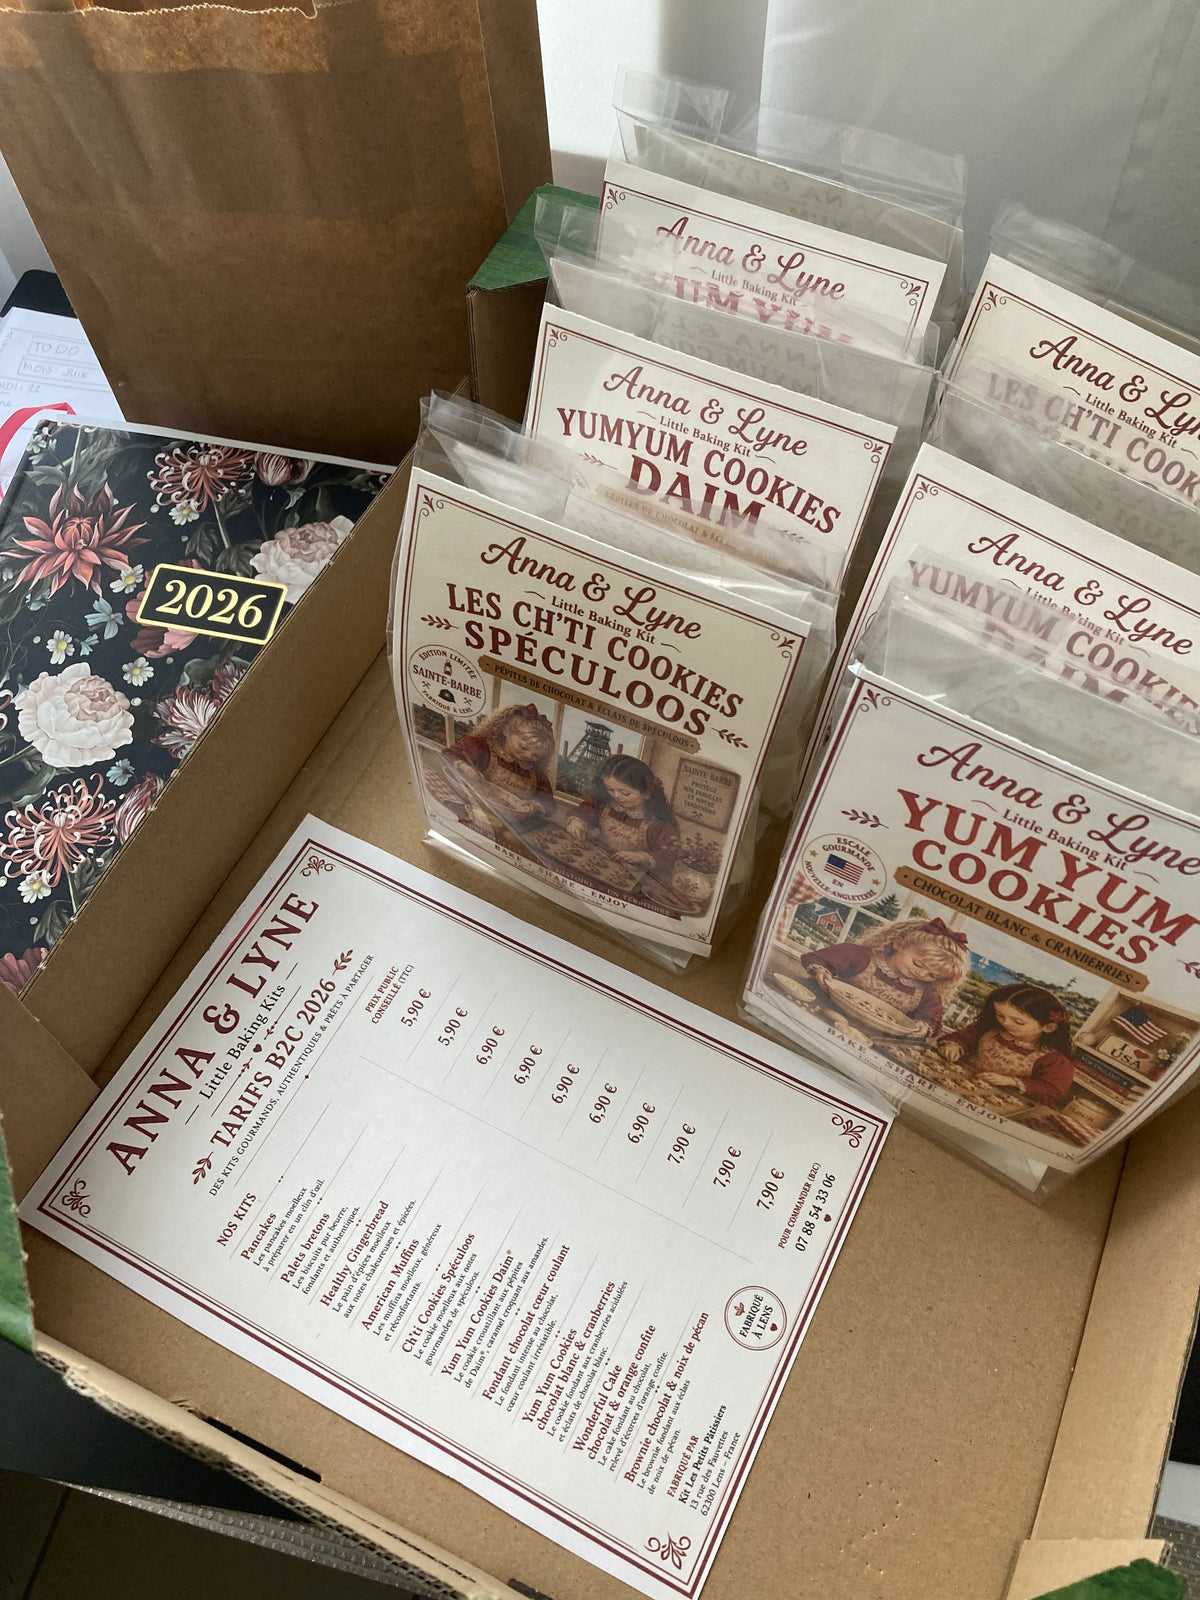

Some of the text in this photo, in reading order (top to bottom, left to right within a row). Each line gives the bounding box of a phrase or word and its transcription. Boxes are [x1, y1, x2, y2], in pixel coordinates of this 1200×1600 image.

[656, 216, 735, 266] Anna
[742, 244, 766, 273] &
[766, 252, 846, 300] Lyne
[711, 269, 739, 287] Little
[741, 280, 778, 301] Baking
[1029, 335, 1116, 391] Anna
[1119, 375, 1149, 403] &
[603, 366, 808, 457] Anna & Lyne
[660, 415, 752, 458] Little Baking Kit
[1044, 395, 1122, 449] CH'TI
[1085, 392, 1178, 449] Little Baking Kit
[556, 407, 841, 534] YUMYUM COOKIES
[625, 454, 767, 538] DAIM
[155, 579, 268, 628] 2026
[480, 537, 702, 639] Anna & Lyne
[551, 596, 656, 645] Little Baking Kit
[908, 560, 1062, 642] YUMYUM
[967, 533, 1065, 592] Anna
[1074, 579, 1104, 606] &
[1103, 594, 1194, 655] Lyne
[1025, 586, 1058, 610] Little
[1105, 628, 1126, 647] Kit
[412, 664, 482, 699] SAINTE-BARBE
[446, 583, 744, 718] LES CH'TI COOKIES
[464, 620, 711, 736] SPÉCULOOS
[494, 664, 527, 684] PÉPITES
[529, 678, 541, 689] DE
[542, 683, 586, 708] CHOCOLAT
[588, 701, 594, 710] &
[629, 717, 641, 728] DE
[917, 742, 1200, 876] Anna & Lyne
[1002, 808, 1129, 871] Little Baking Kit
[494, 844, 522, 863] BAKE
[538, 866, 576, 889] SHARE
[591, 890, 629, 909] ENJOY
[822, 837, 876, 872] ESCALE GOURMANDE
[831, 879, 844, 888] EN
[897, 788, 1200, 947] YUM YUM
[911, 839, 1160, 964] COOKIES
[912, 876, 1133, 984] CHOCOLAT BLANC & CRANBERRIES
[364, 965, 399, 1013] PRIX PUBLIC
[370, 963, 414, 1024] CONSEILLÉ (TTC)
[400, 987, 431, 1027] 5,90 €
[105, 891, 320, 1176] ANNA & LYNE
[198, 984, 285, 1099] Little Baking Kits
[209, 977, 336, 1147] TARIFS B2C 2026
[475, 1025, 505, 1065] 6,90 €
[1110, 1048, 1141, 1070] USA
[208, 1177, 225, 1196] DES
[220, 1155, 239, 1177] KITS
[236, 1097, 280, 1155] GOURMANDS,
[276, 1030, 322, 1096] AUTHENTIQUES
[319, 1024, 327, 1032] &
[323, 999, 344, 1023] PRÊTS
[344, 954, 374, 992] PARTAGER
[550, 1063, 580, 1104] 6,90 €
[827, 1027, 868, 1054] BAKE
[884, 1060, 939, 1093] SHARE
[956, 1098, 1008, 1125] ENJOY
[216, 1192, 257, 1247] NOS KITS
[252, 1186, 307, 1266] Les pancakes moelleux
[755, 1167, 785, 1210] 7,90 €
[777, 1161, 821, 1249] POUR COMMANDER (B2C)
[794, 1172, 836, 1251] 07 88 54 33 06
[239, 1212, 277, 1260] Pancakes
[279, 1212, 330, 1283] Palets bretons
[319, 1199, 389, 1306] Healthy Gingerbread
[401, 1232, 475, 1353] Ch'ti Cookies Spéculoos
[738, 1293, 764, 1338] FABRIQUÉ
[749, 1304, 773, 1340] À LENS
[494, 1294, 559, 1406] Le fondant intense au chocolat,
[572, 1364, 622, 1450] Wonderful Cake
[666, 1434, 699, 1497] FABRIQUÉ PAR
[677, 1404, 727, 1504] Kit Les Petits Pâtissiers
[689, 1430, 729, 1510] 13 rue des Fauvettes
